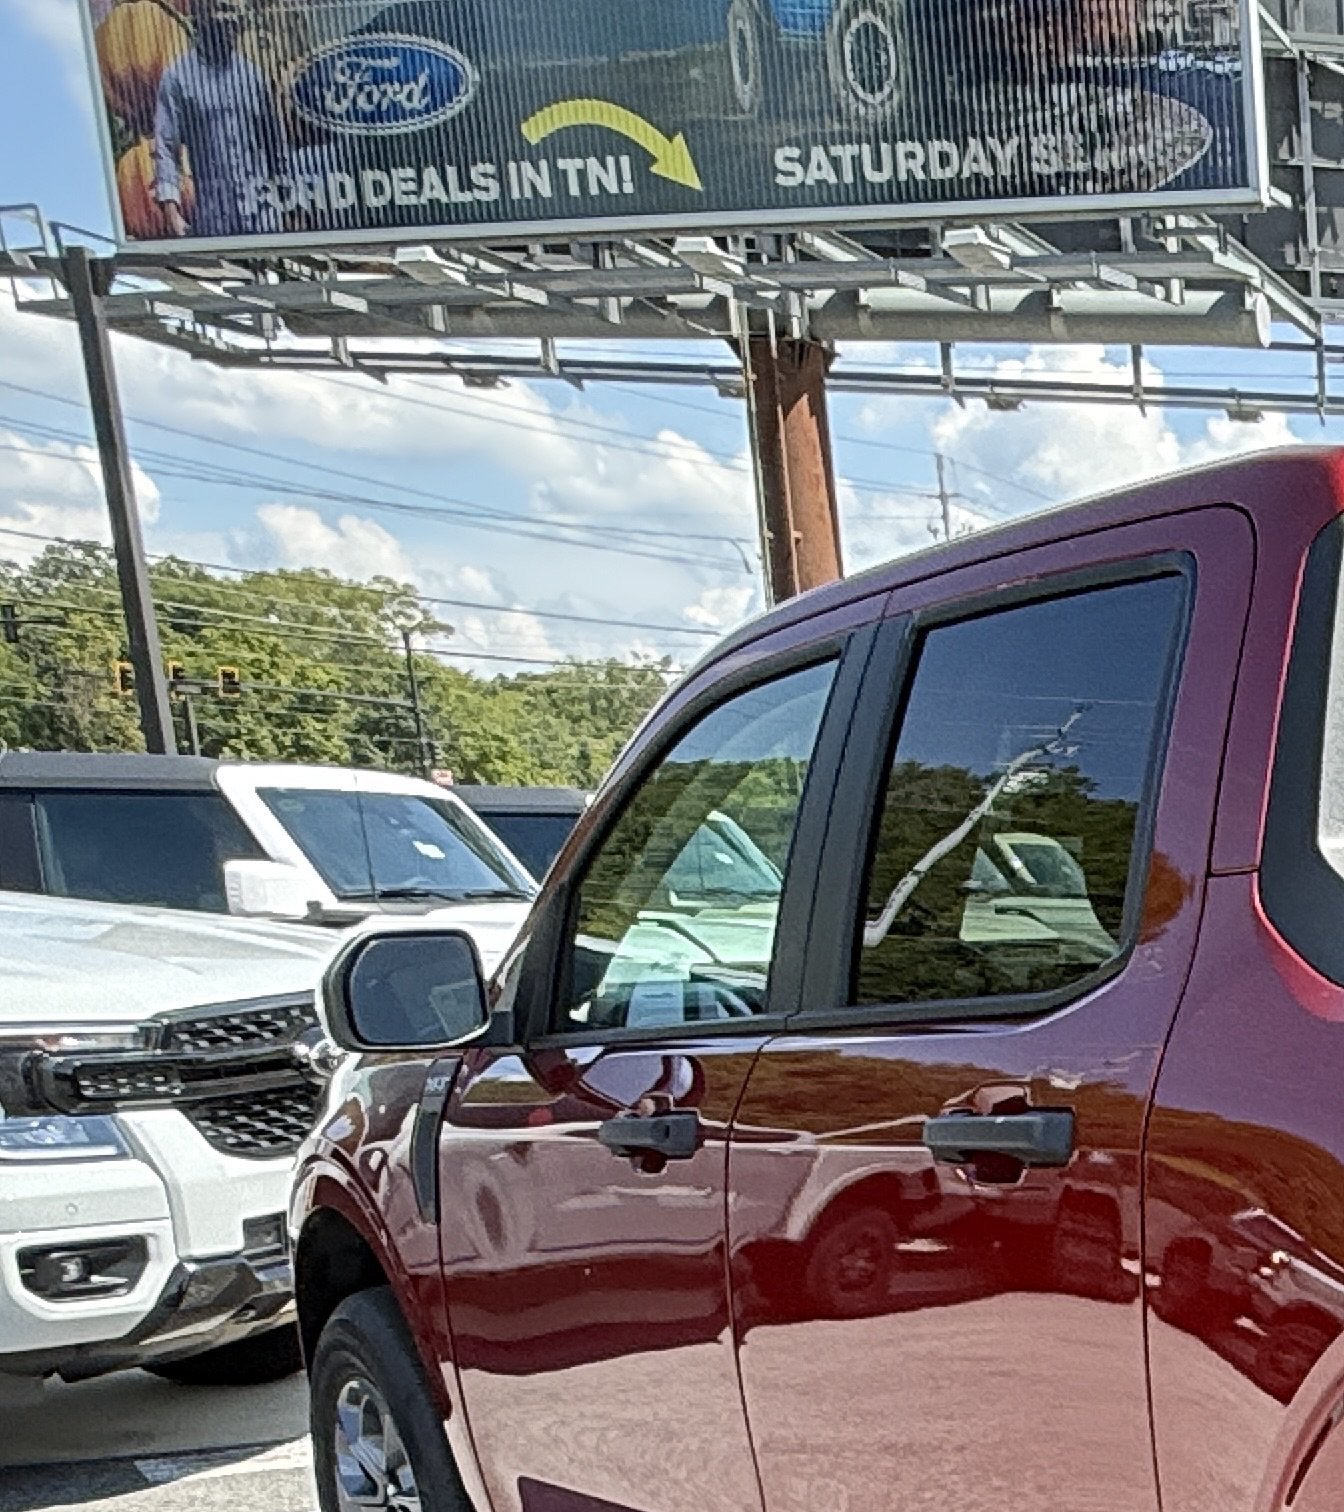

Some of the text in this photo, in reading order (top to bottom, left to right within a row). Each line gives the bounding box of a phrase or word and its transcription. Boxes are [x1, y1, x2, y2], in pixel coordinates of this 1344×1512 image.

[324, 52, 431, 113] Ford
[361, 163, 499, 207] DEALS
[508, 158, 552, 200] IN
[556, 154, 634, 196] TN!
[774, 134, 1020, 187] SATURDAY
